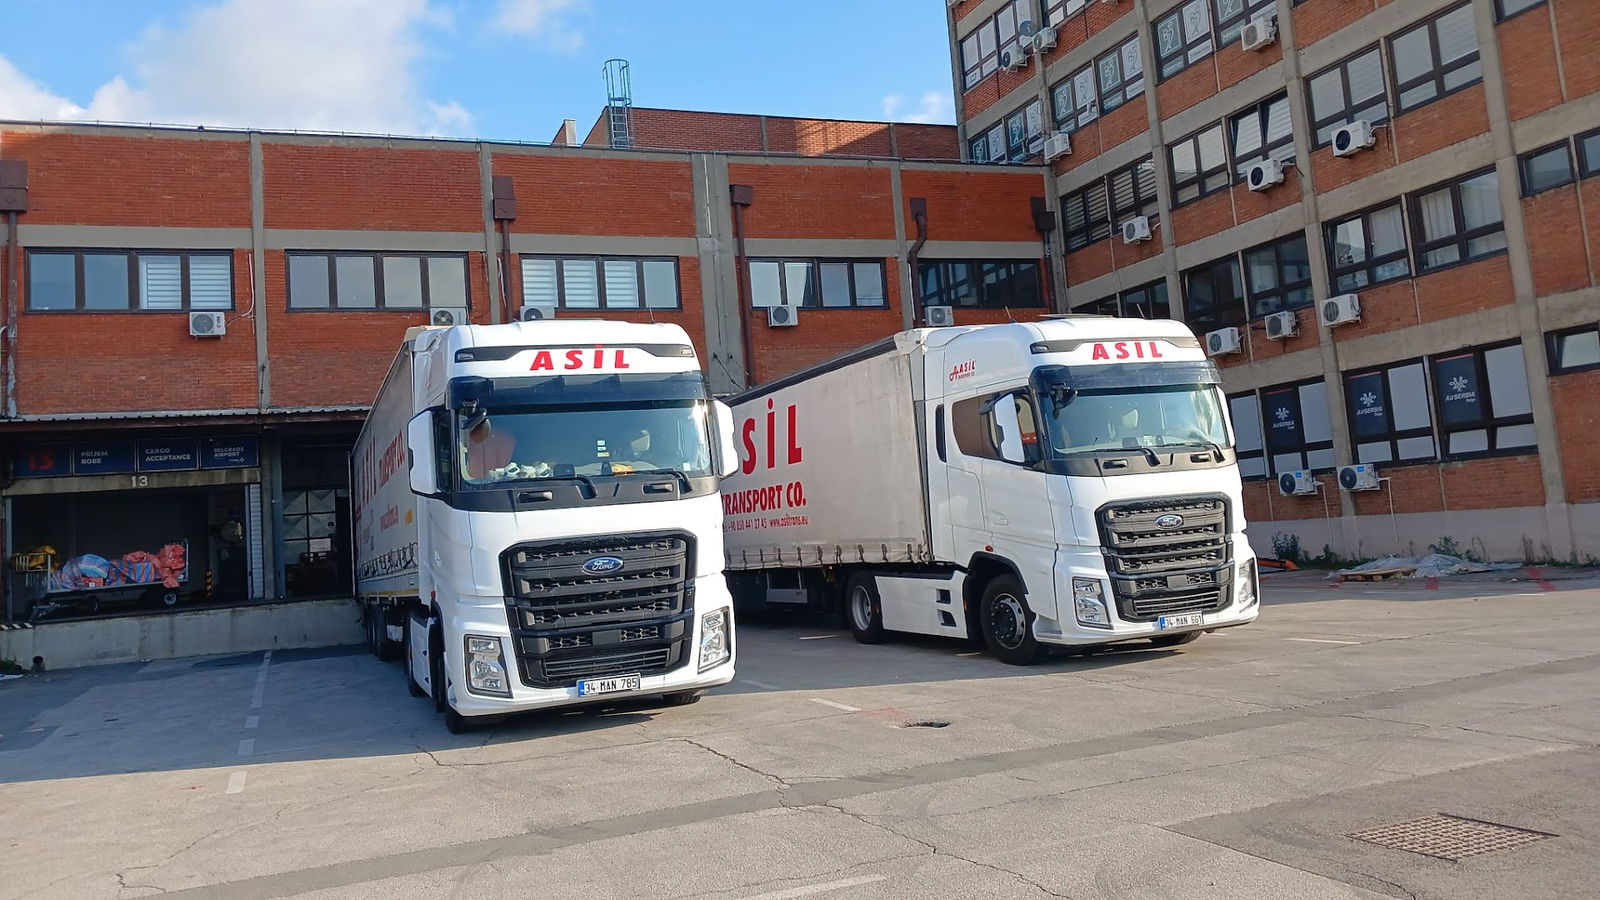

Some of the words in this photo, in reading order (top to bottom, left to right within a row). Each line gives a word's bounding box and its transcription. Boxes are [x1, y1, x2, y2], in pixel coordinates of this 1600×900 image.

[530, 344, 629, 371] ASİL
[1445, 391, 1475, 402] AirSERBIA
[742, 397, 802, 475] SİL
[81, 450, 108, 458] PRIJEM
[145, 454, 191, 462] ACCEPTANCE
[131, 476, 148, 487] 13
[786, 481, 806, 508] CO.
[592, 559, 615, 571] Ford
[585, 682, 596, 694] 34
[600, 679, 617, 692] MAN
[621, 677, 637, 689] 785
